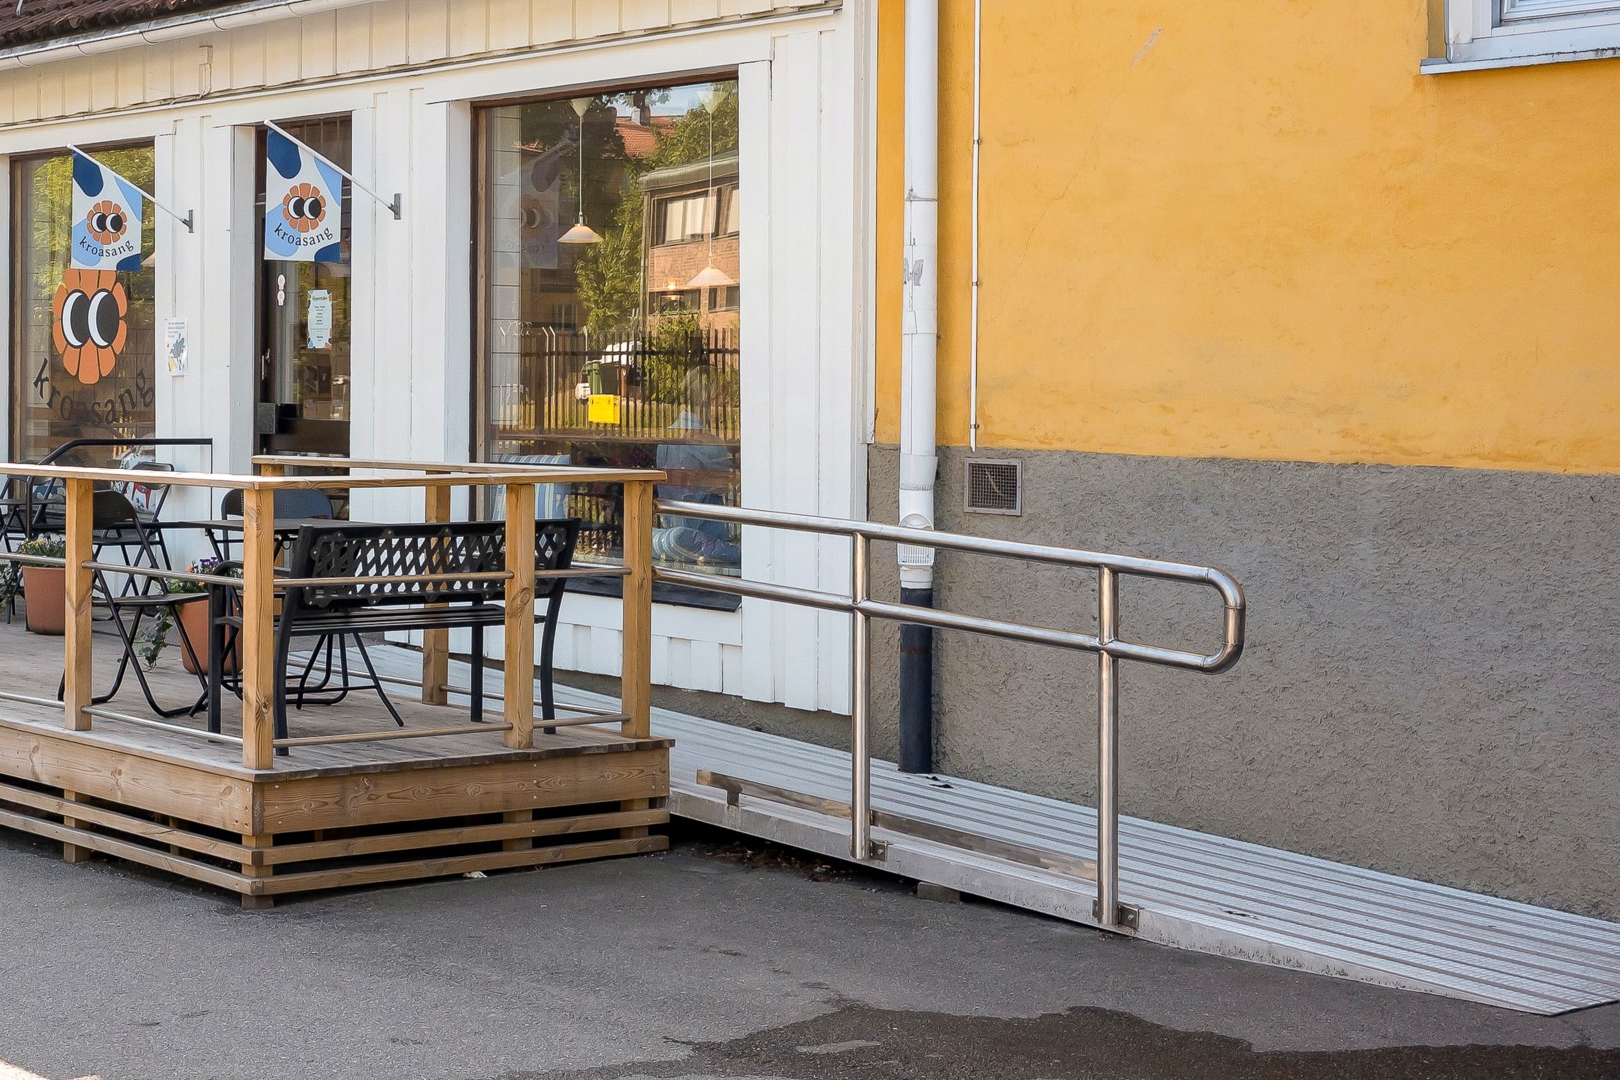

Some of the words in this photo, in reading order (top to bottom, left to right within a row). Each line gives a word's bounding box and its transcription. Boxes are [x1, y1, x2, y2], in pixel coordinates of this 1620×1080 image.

[79, 235, 134, 257] kroasang
[274, 222, 333, 246] kroasang
[33, 357, 155, 426] kroasang
